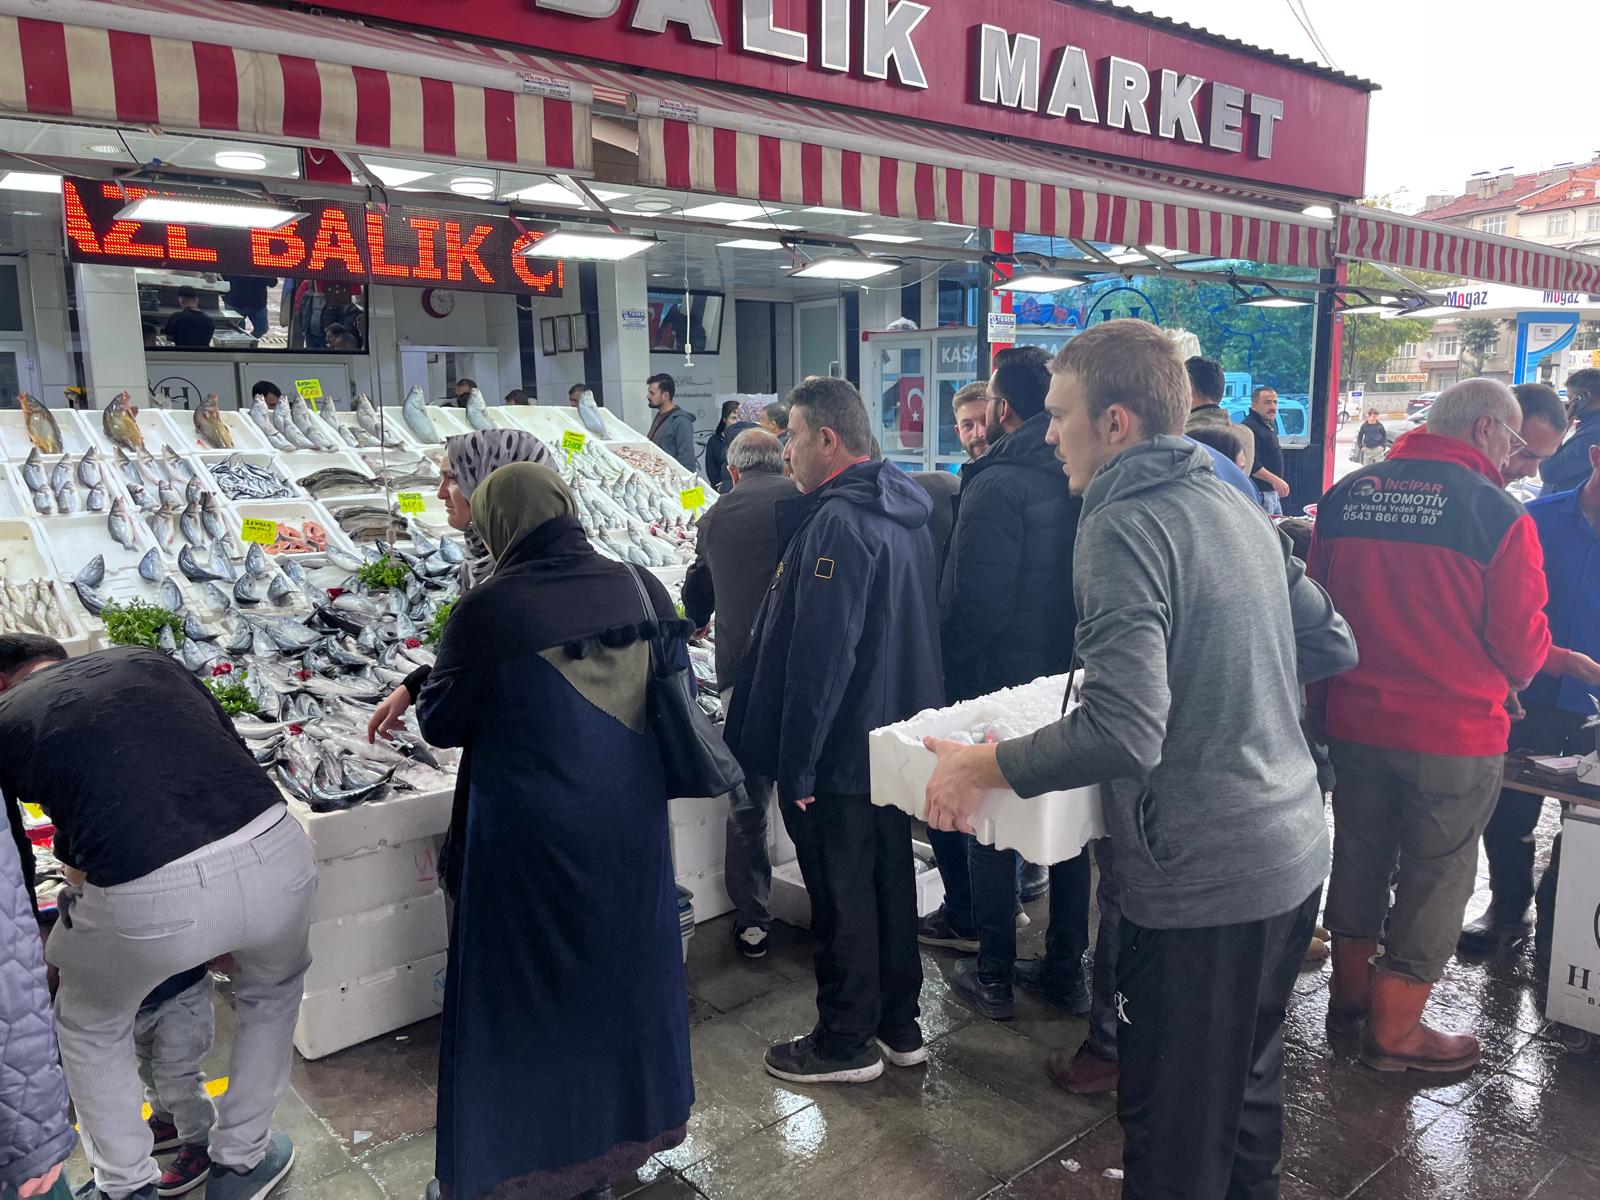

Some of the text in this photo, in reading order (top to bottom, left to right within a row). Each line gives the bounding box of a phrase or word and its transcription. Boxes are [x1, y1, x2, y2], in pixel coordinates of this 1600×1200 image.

[535, 0, 1285, 159] LIK MARKET
[1446, 290, 1488, 308] Mogaz
[941, 346, 978, 364] KASA
[1384, 478, 1444, 493] İNCİPAR
[1372, 492, 1448, 507] OTOMOTİV
[1389, 504, 1415, 513] Yedek
[1417, 506, 1443, 516] Parça
[1343, 512, 1437, 525] 0543 866 08 90
